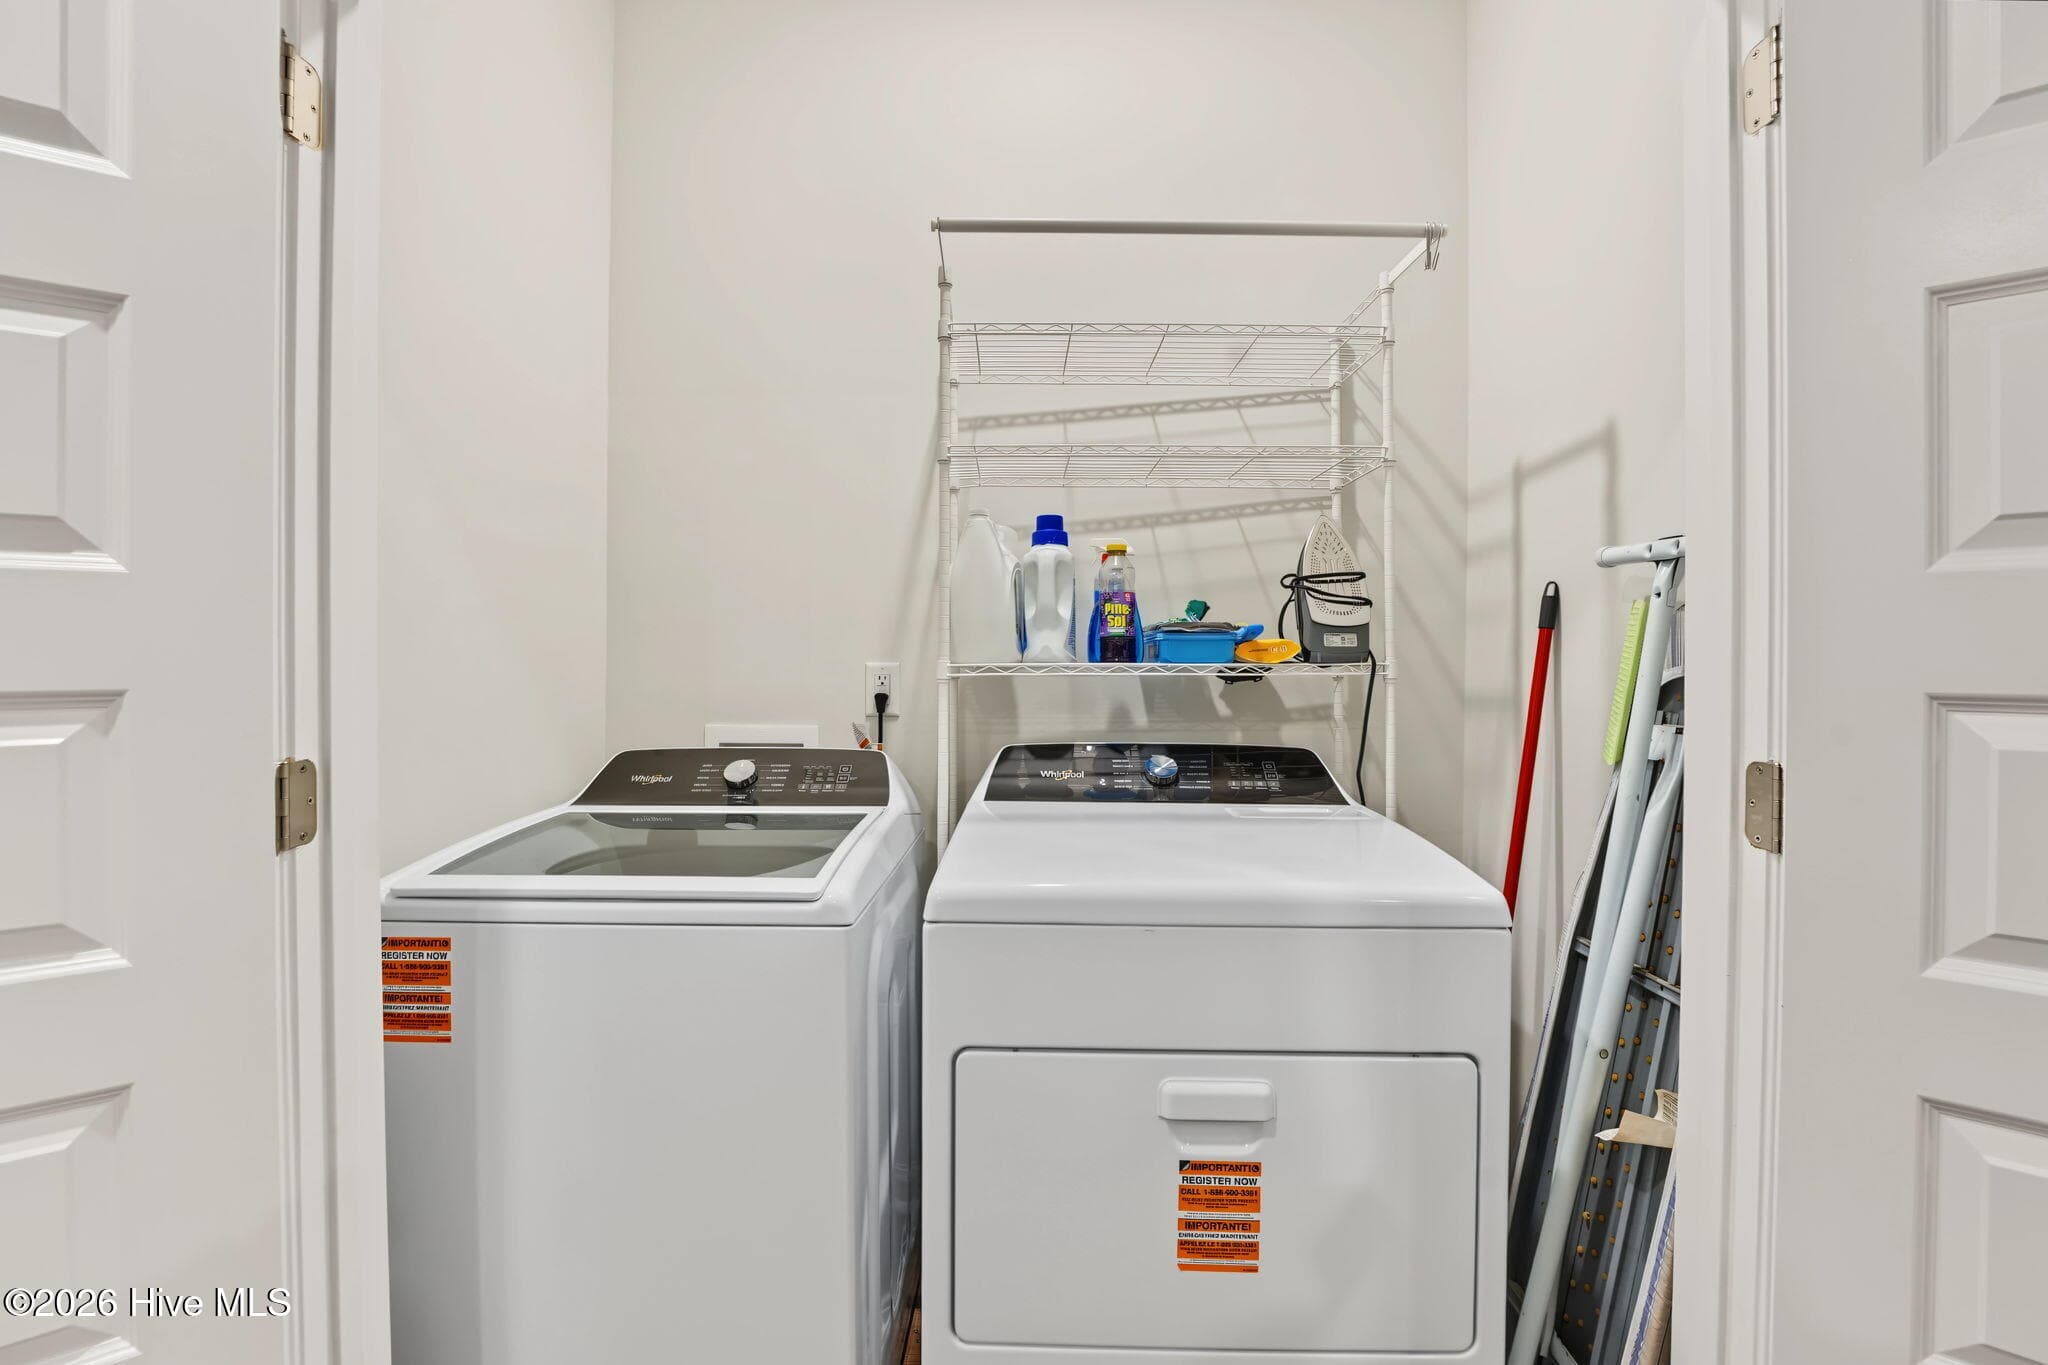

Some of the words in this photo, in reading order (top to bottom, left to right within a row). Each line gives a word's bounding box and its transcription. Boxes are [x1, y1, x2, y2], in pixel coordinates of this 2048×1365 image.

[631, 774, 674, 785] Whirlpool
[1040, 770, 1085, 780] Whirlpool
[381, 952, 424, 960] REGISTER
[426, 952, 448, 960] NOW
[1181, 1176, 1231, 1185] REGISTER
[1234, 1177, 1258, 1186] NOW
